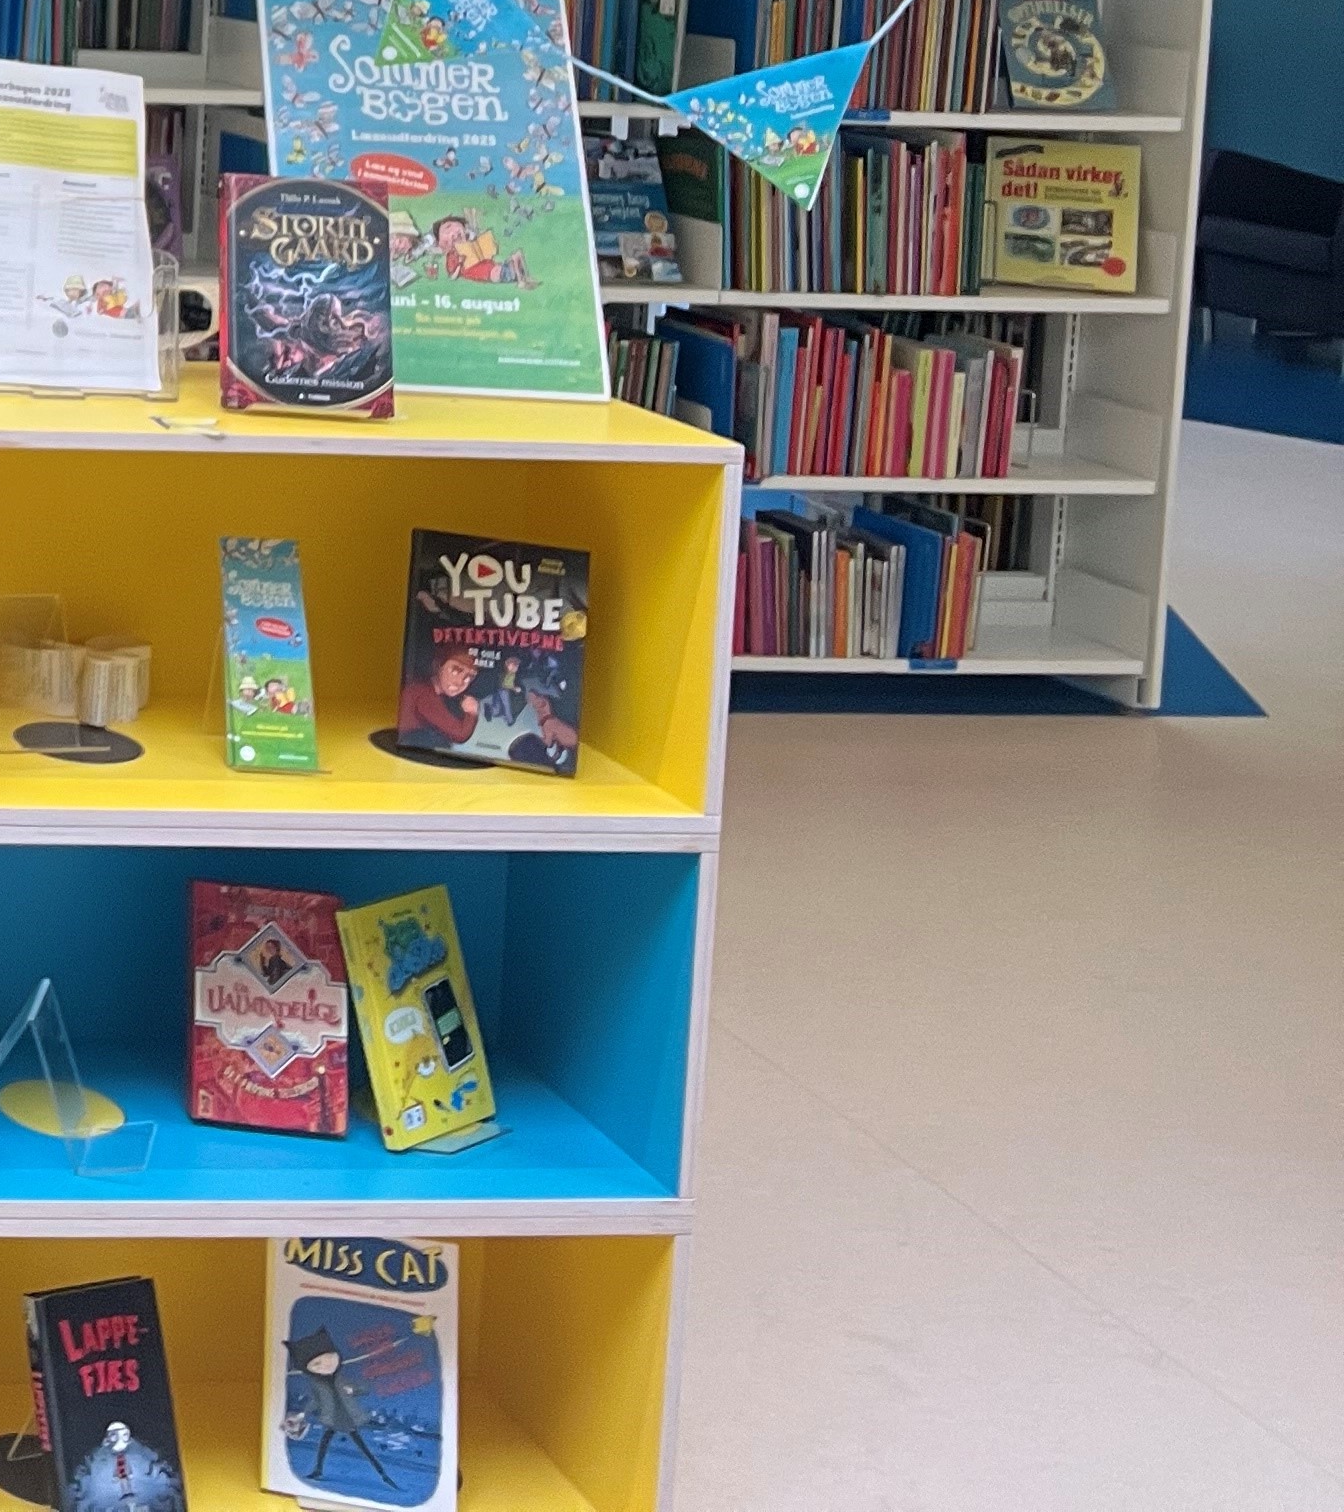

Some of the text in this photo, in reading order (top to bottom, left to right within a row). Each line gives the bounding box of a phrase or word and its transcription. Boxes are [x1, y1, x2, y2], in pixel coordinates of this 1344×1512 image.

[251, 206, 371, 239] STORM
[270, 237, 374, 269] GAARD
[390, 293, 416, 307] uni
[434, 294, 456, 309] 16.
[461, 296, 521, 315] august
[439, 552, 531, 597] YOU
[463, 589, 565, 631] TUBE
[433, 627, 564, 651] DETEKTIVERNE
[285, 1237, 443, 1285] MISS CAT
